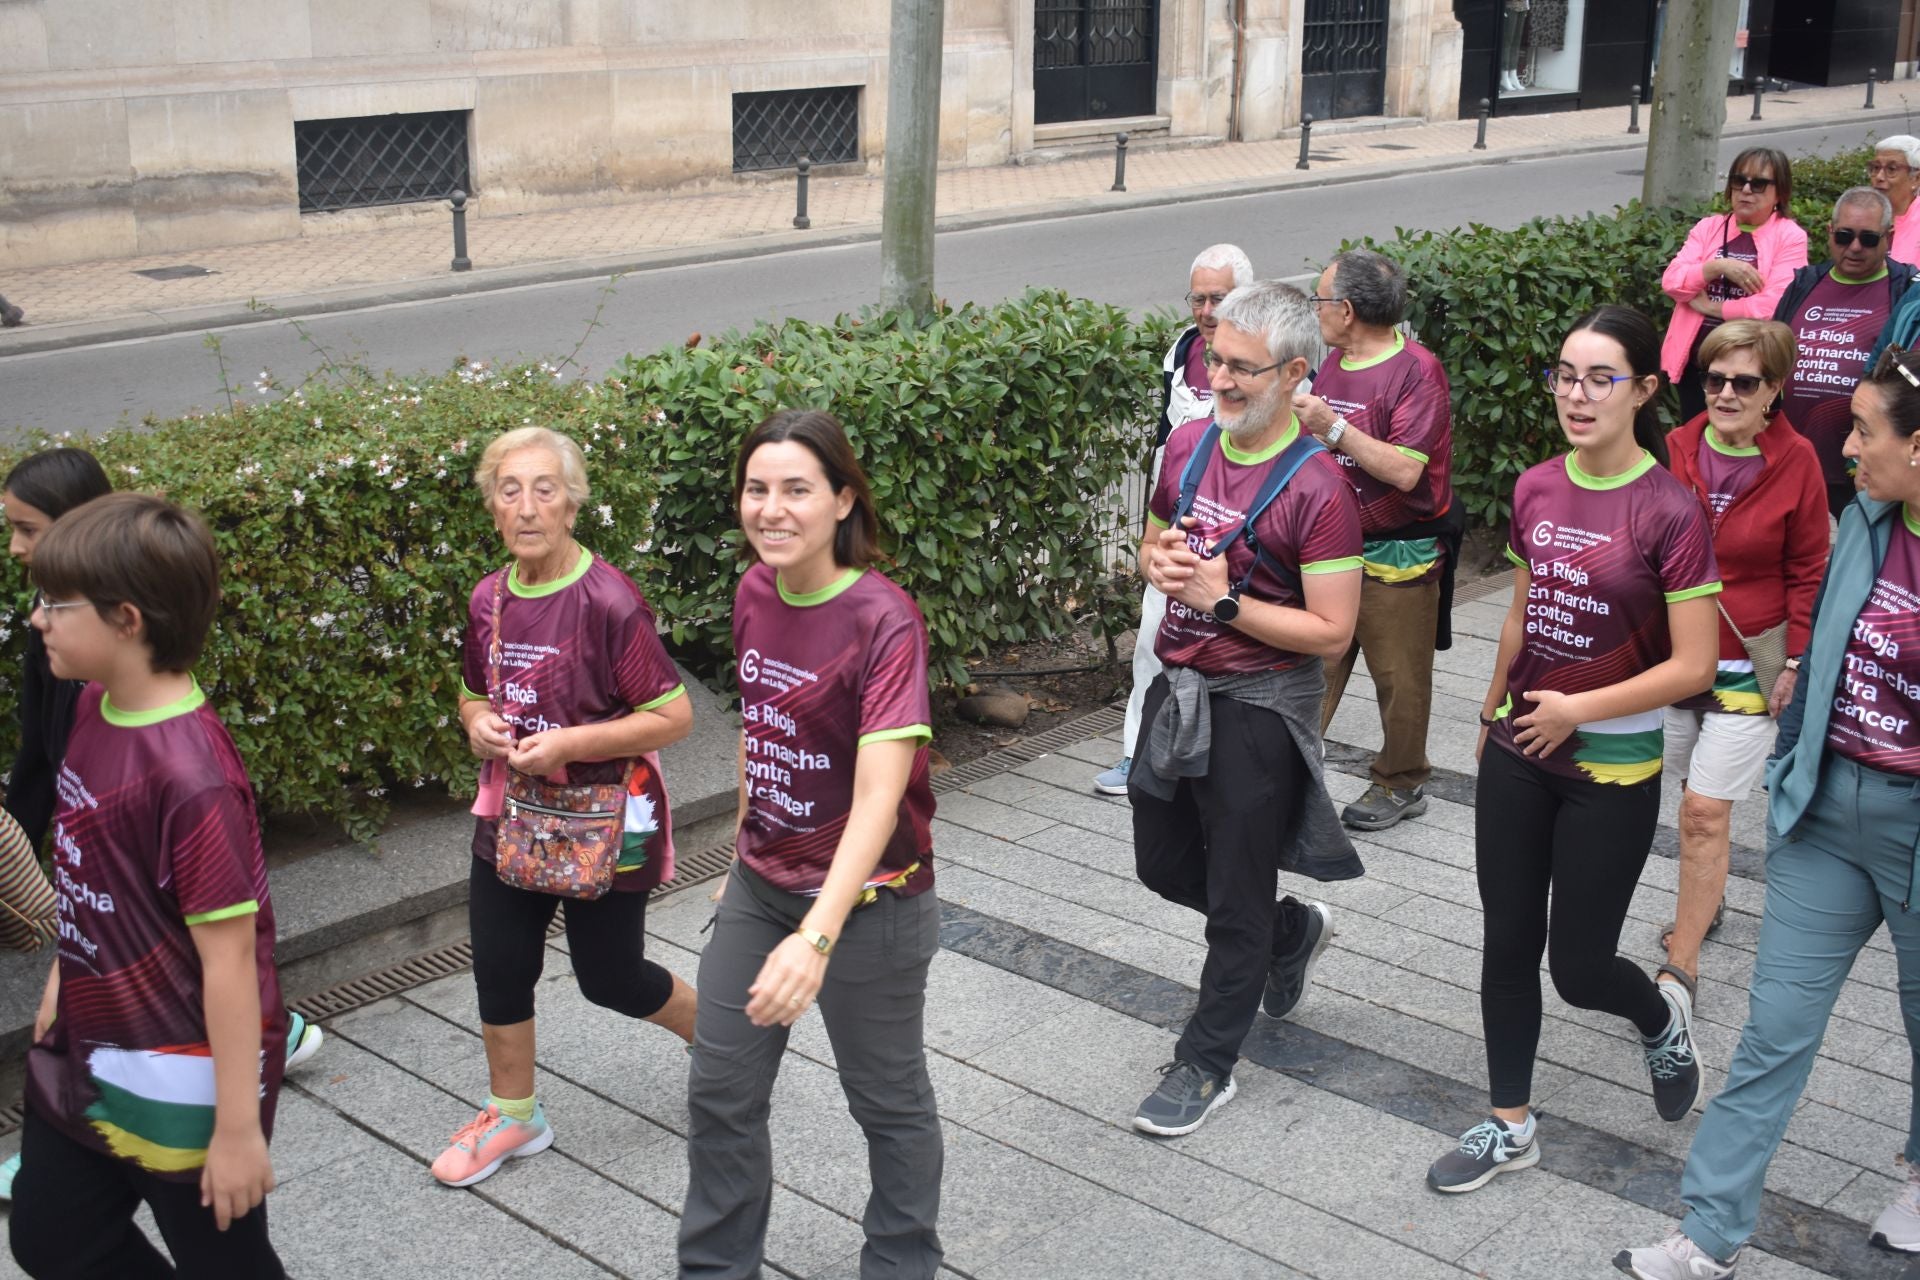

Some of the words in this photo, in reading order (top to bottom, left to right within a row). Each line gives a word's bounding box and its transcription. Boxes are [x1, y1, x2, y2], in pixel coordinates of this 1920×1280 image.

[1800, 328, 1816, 340] La
[1820, 330, 1855, 345] Rioja
[1798, 344, 1813, 356] En
[1815, 348, 1871, 361] marcha
[1796, 359, 1839, 371] contra
[1793, 369, 1805, 381] el
[1806, 371, 1858, 387] cáncer
[1192, 502, 1214, 516] contra
[1199, 512, 1208, 522] La
[1555, 533, 1575, 542] contra
[1580, 537, 1598, 546] cáncer
[1557, 526, 1586, 536] asociación
[1586, 531, 1612, 543] española
[1563, 541, 1571, 549] La
[1186, 533, 1213, 558] Rio
[1530, 558, 1549, 577] La
[1553, 561, 1589, 587] Rioja
[1876, 578, 1908, 598] sociación
[1528, 583, 1549, 600] En
[1553, 589, 1610, 616] marcha
[1871, 595, 1881, 606] La
[1880, 600, 1900, 615] Rioja
[1873, 588, 1890, 599] ntra
[1890, 593, 1899, 602] el
[1898, 598, 1920, 613] cáncer
[1527, 604, 1575, 626] contra
[1526, 619, 1543, 634] el
[1543, 624, 1594, 649] cáncer
[741, 697, 758, 722] La
[763, 704, 796, 737] Rioja
[1833, 697, 1909, 735] cáncer
[763, 741, 831, 770] marcha
[745, 757, 792, 787] ontra
[756, 784, 815, 817] cáncer
